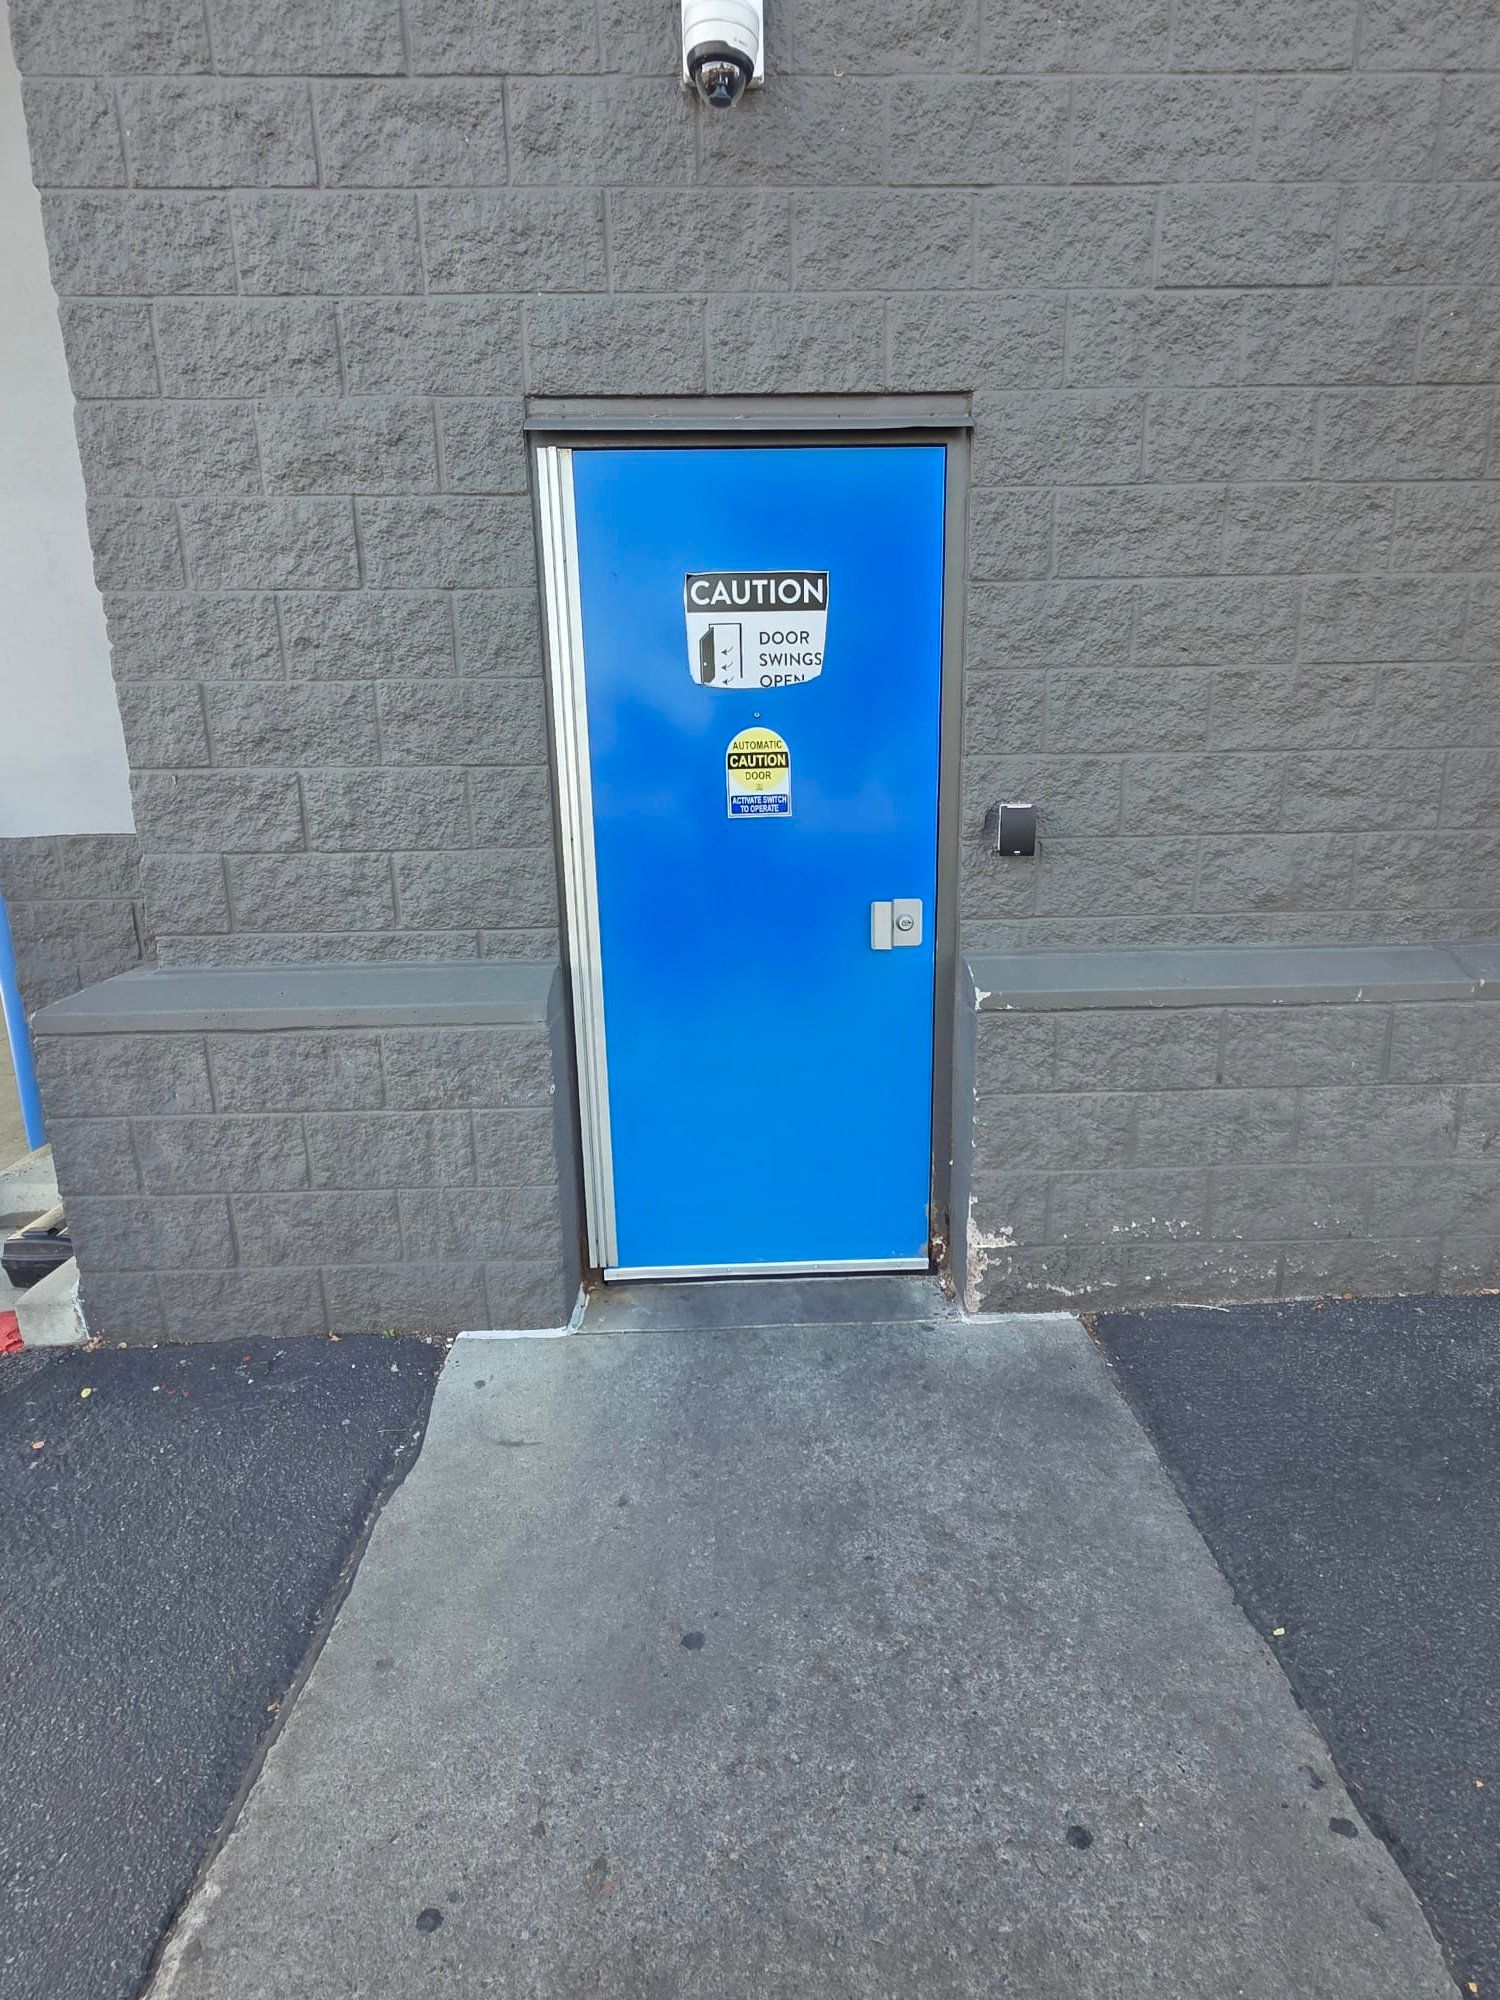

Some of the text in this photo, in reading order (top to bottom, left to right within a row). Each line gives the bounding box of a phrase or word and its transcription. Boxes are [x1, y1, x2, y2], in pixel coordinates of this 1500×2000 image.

[690, 579, 823, 605] CAUTION
[759, 631, 810, 645] DOOR
[759, 652, 822, 667] SWINGS
[733, 741, 782, 750] AUTOMATIC
[730, 754, 785, 767] CAUTION
[745, 771, 771, 780] DOOR
[732, 795, 787, 804] ACTIVATE SWITCH
[750, 804, 779, 812] OPERATE
